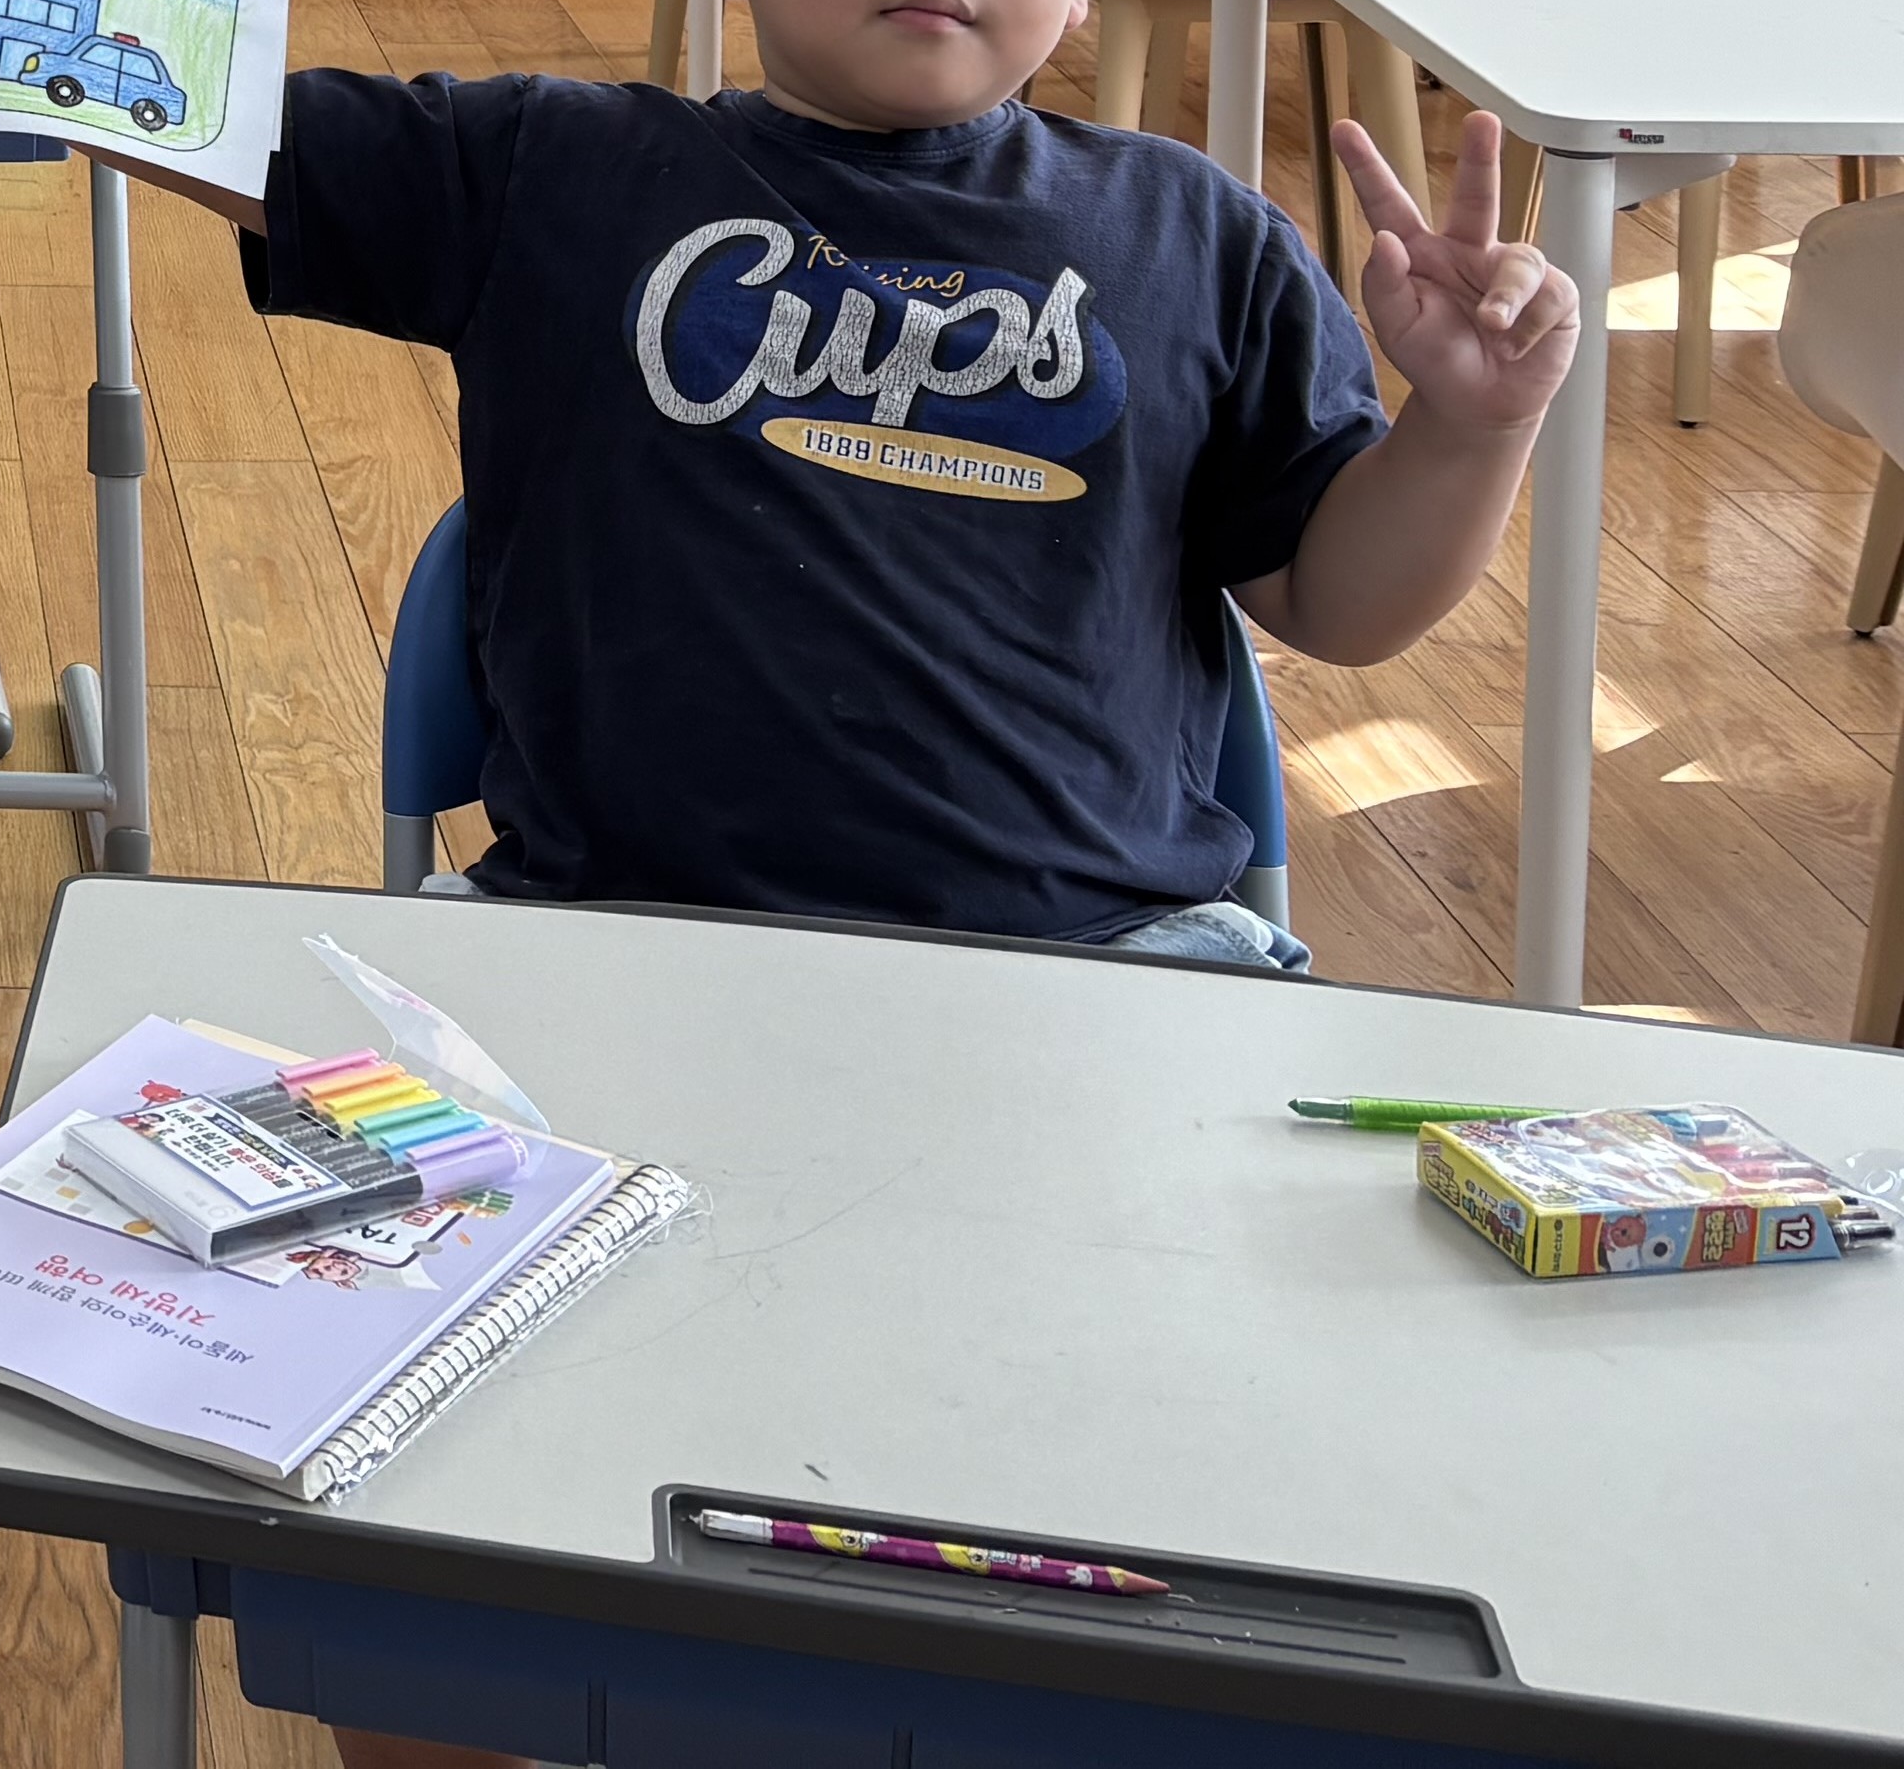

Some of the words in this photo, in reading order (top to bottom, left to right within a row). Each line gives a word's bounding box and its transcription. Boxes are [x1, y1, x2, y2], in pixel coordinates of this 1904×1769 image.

[636, 218, 1087, 426] Cups
[804, 428, 871, 461] 1888
[879, 443, 1043, 490] CHAMPIONS
[1776, 1215, 1815, 1251] 12
[27, 1279, 76, 1303] 함께
[36, 1254, 104, 1286] 여행
[110, 1279, 215, 1328] 지방세
